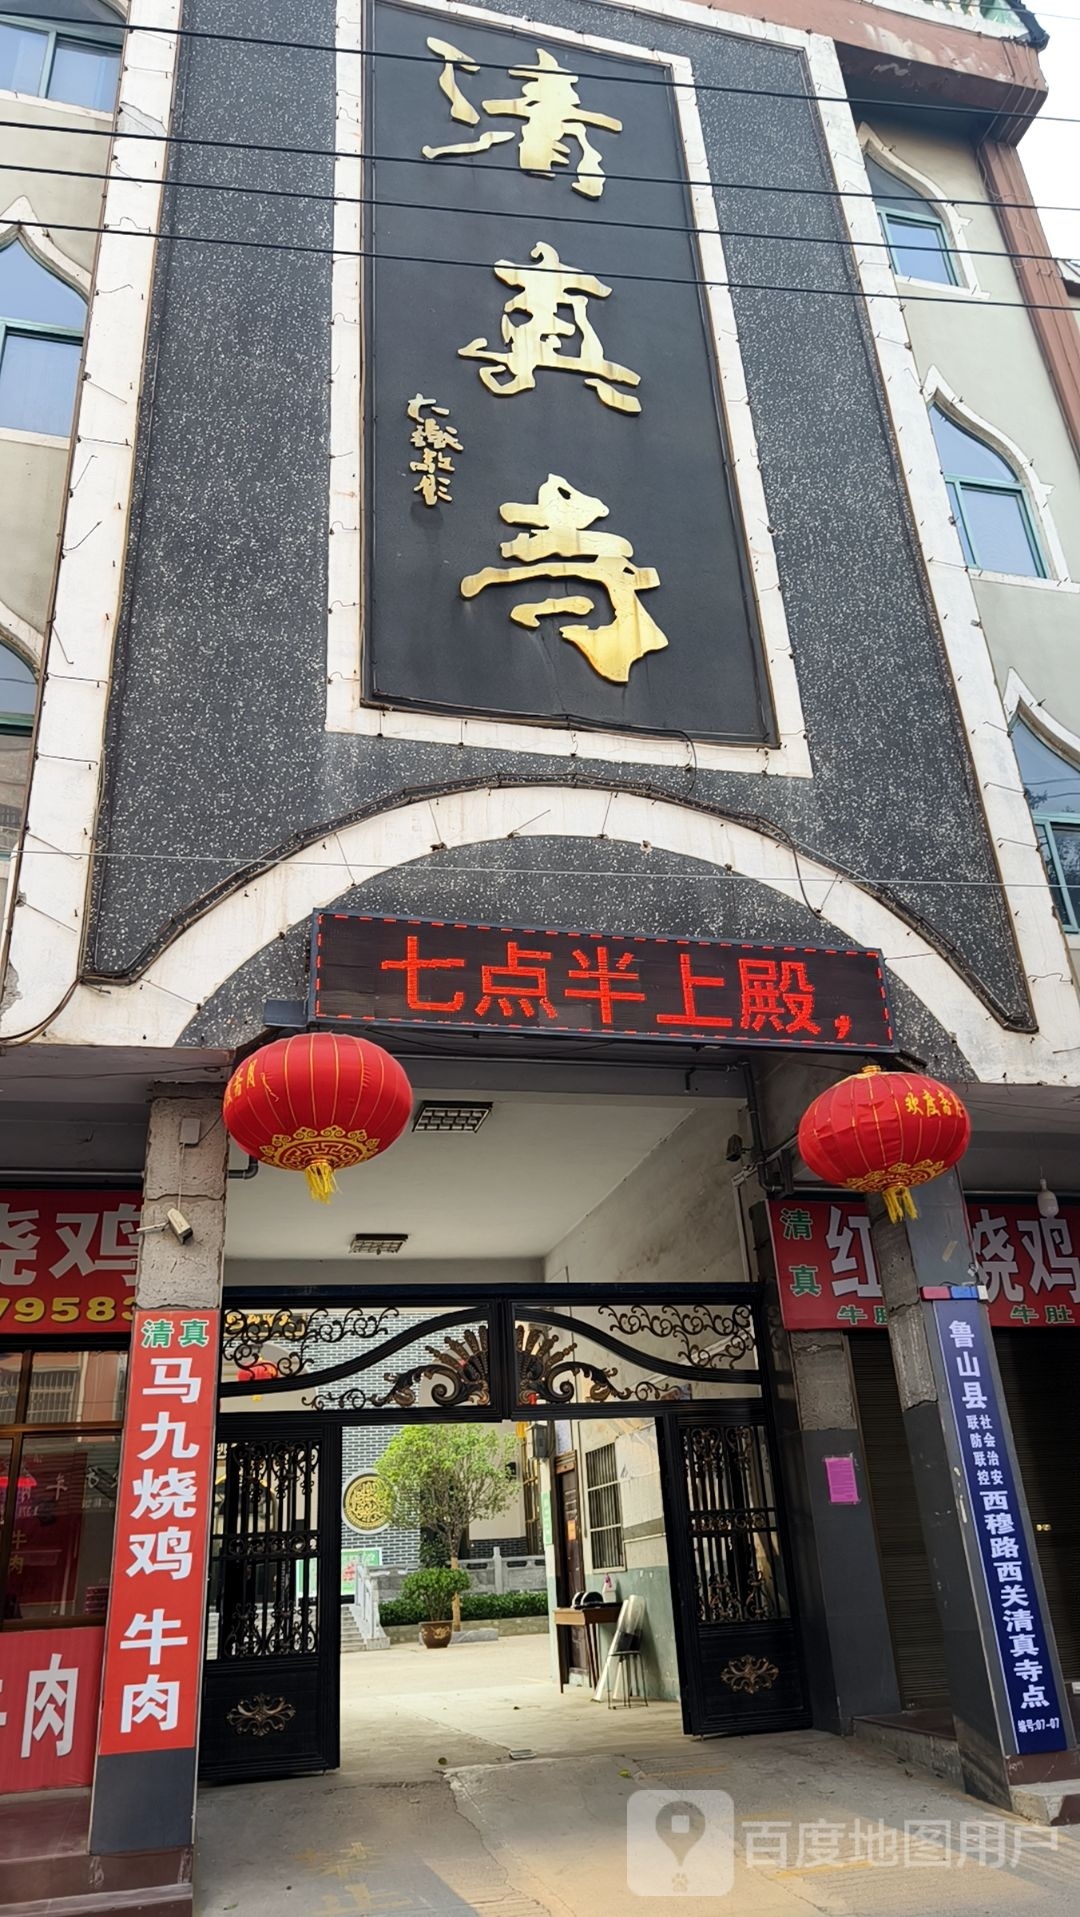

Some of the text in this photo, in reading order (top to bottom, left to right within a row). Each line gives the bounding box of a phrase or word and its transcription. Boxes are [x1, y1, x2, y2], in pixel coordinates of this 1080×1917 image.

[421, 36, 669, 684] 清真寺
[780, 1208, 821, 1297] 清真
[141, 1319, 210, 1348] 清真
[949, 1320, 988, 1410] 鲁山县
[119, 1357, 202, 1734] 马九烧鸡 牛肉
[980, 1490, 1050, 1710] 西穆路西关清真寺点
[0, 1653, 79, 1759] 肉
